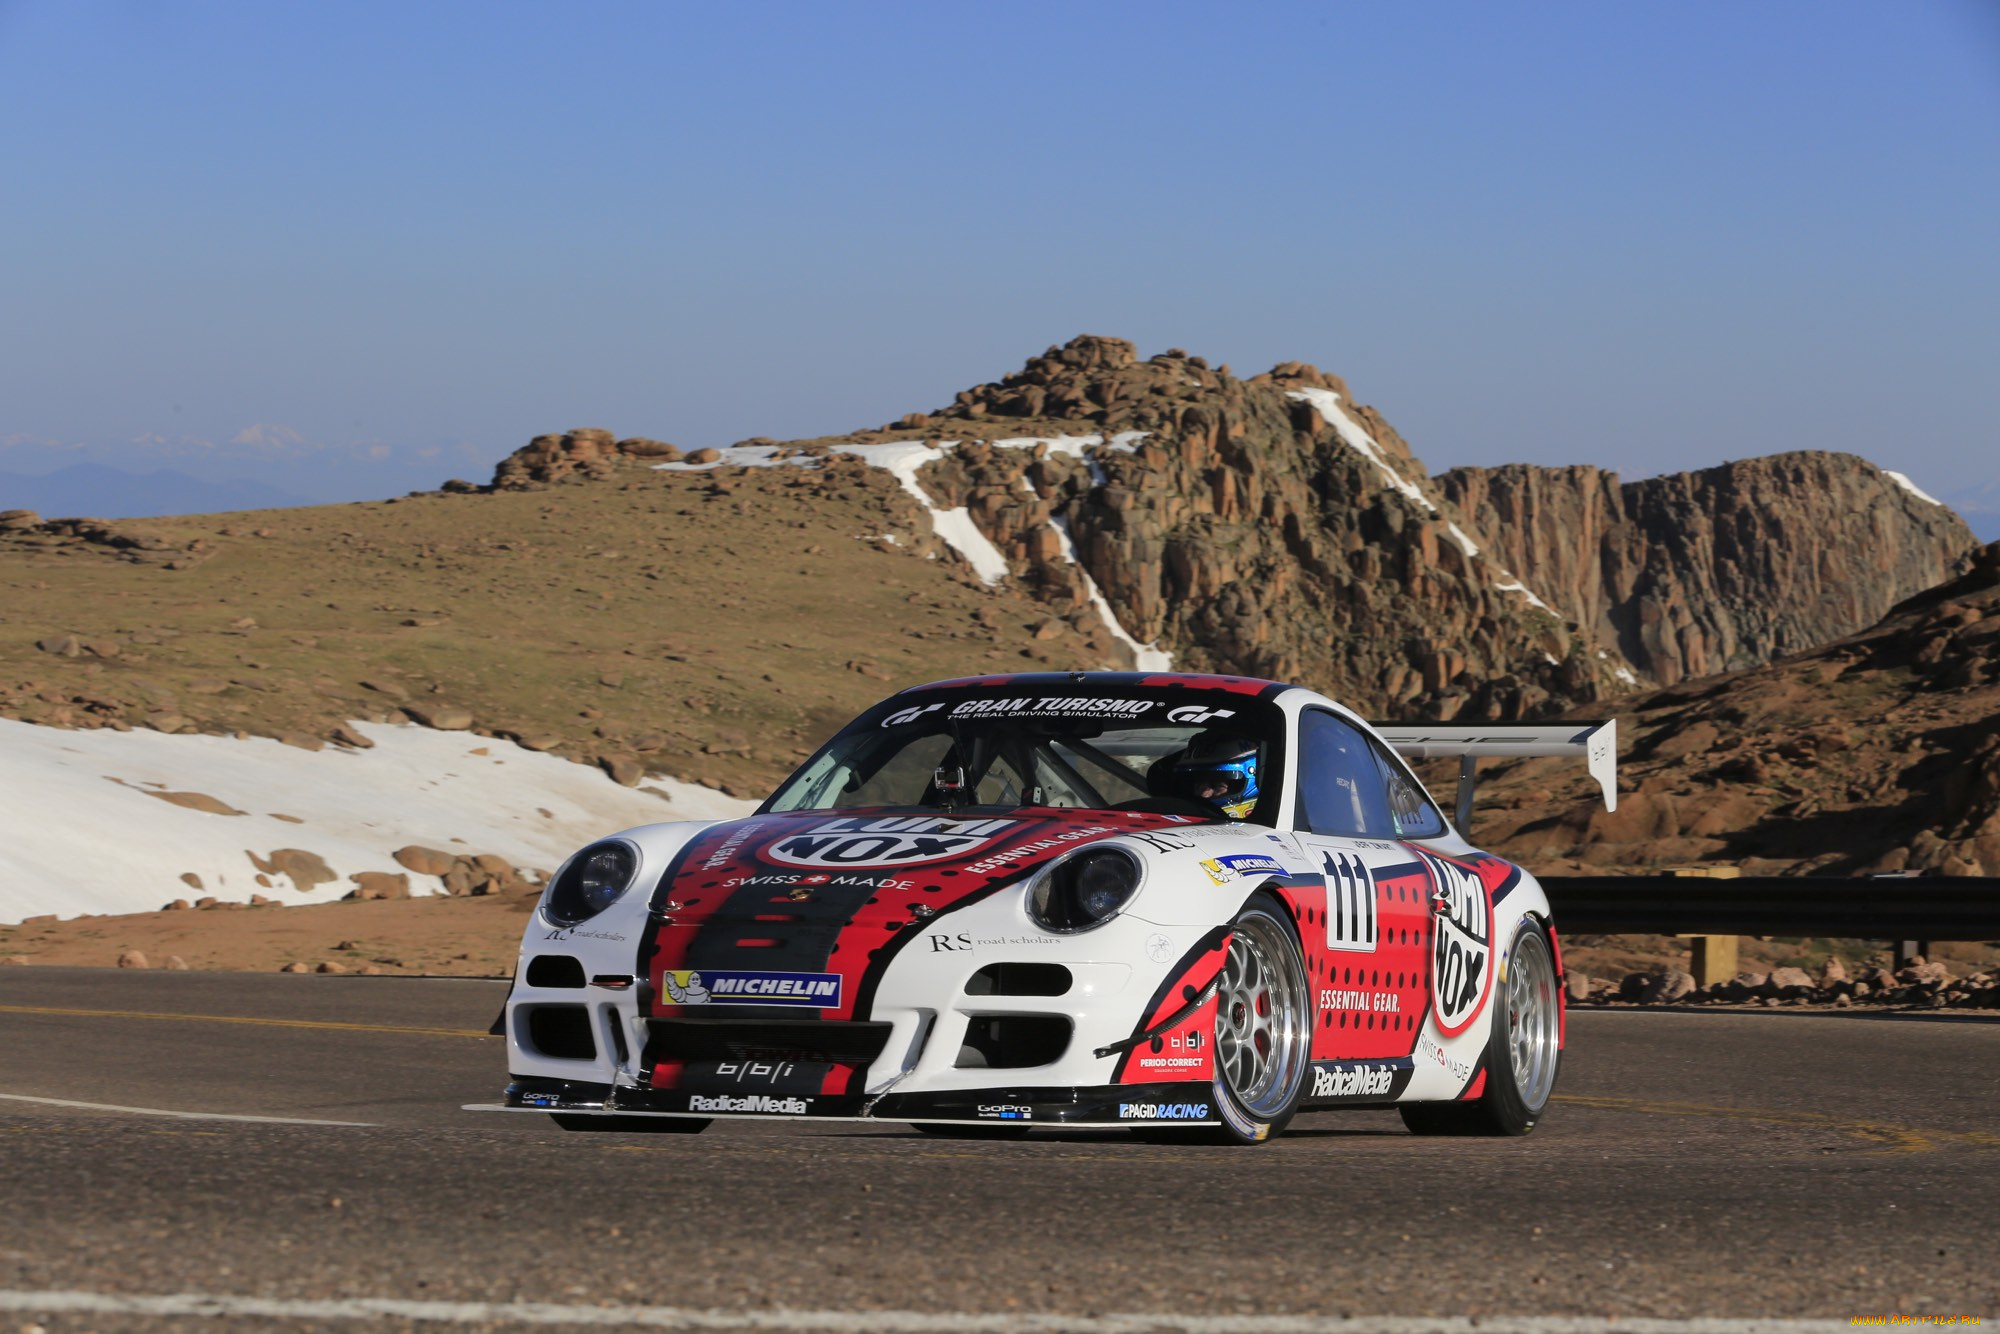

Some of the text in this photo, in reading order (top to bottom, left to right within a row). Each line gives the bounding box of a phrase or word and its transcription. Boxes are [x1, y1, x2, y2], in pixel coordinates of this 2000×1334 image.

[952, 697, 1154, 714] GRAN TURISMO
[1061, 711, 1137, 719] SIMULATOR
[806, 817, 1019, 836] LUMI
[776, 836, 974, 863] NOX
[964, 839, 1066, 874] ESSENTIAL
[1231, 859, 1283, 871] MICHELIN
[722, 874, 915, 891] SWISS MADE
[1322, 850, 1372, 943] 111
[927, 932, 1061, 953] RS road scholars
[712, 978, 837, 997] MICHELIN
[1320, 989, 1400, 1013] ESSENTIAL GEAR.
[1140, 1058, 1203, 1067] PERIOD CORRECT
[1445, 1055, 1469, 1082] MADE
[977, 1104, 1032, 1113] GoPro
